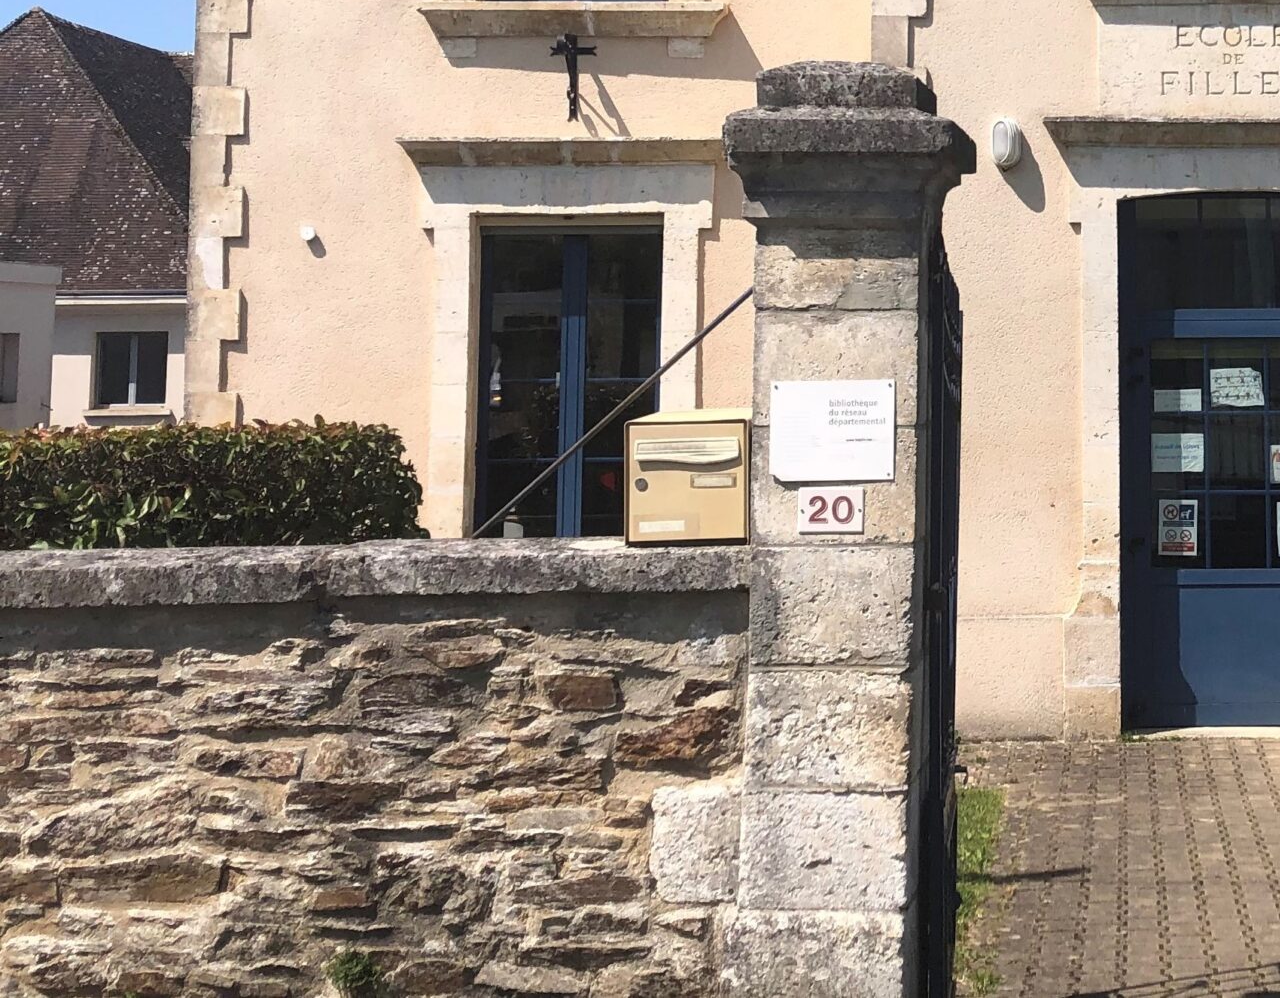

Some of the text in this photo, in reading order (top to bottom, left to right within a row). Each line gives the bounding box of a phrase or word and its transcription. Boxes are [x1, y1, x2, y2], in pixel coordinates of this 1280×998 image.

[1222, 53, 1244, 65] DE
[829, 417, 886, 427] départemental
[808, 495, 855, 524] 20
